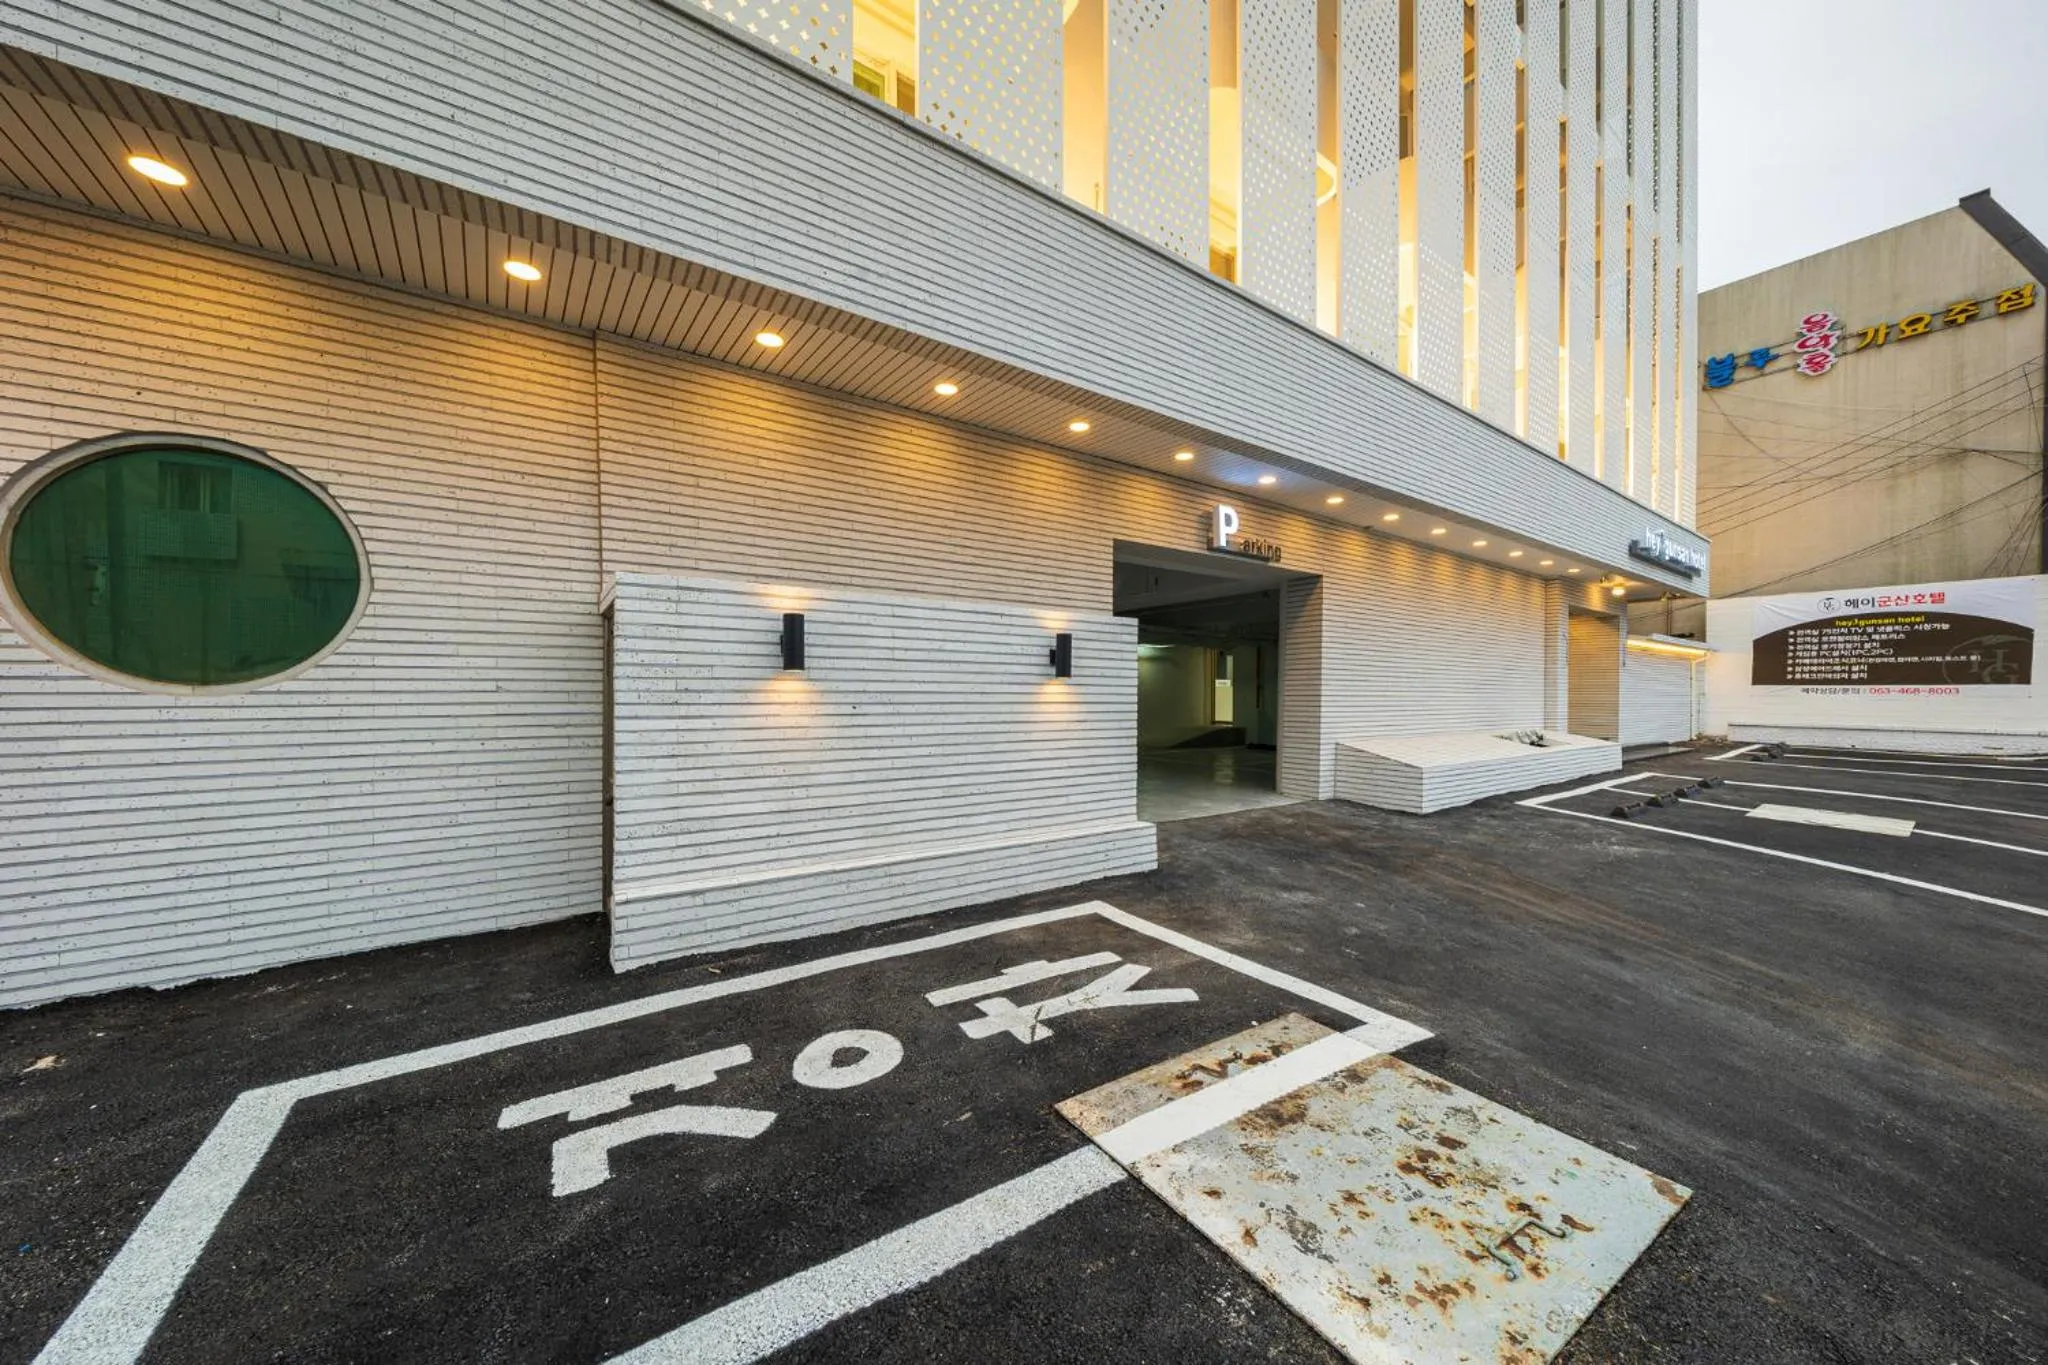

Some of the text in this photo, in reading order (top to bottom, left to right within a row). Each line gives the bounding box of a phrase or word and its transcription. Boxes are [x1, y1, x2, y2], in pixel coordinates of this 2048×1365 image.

[1856, 282, 2036, 350] 가요주점
[1898, 615, 1925, 624] hotel
[1869, 687, 1960, 695] 063-468-8003
[498, 951, 1199, 1197] 경차
